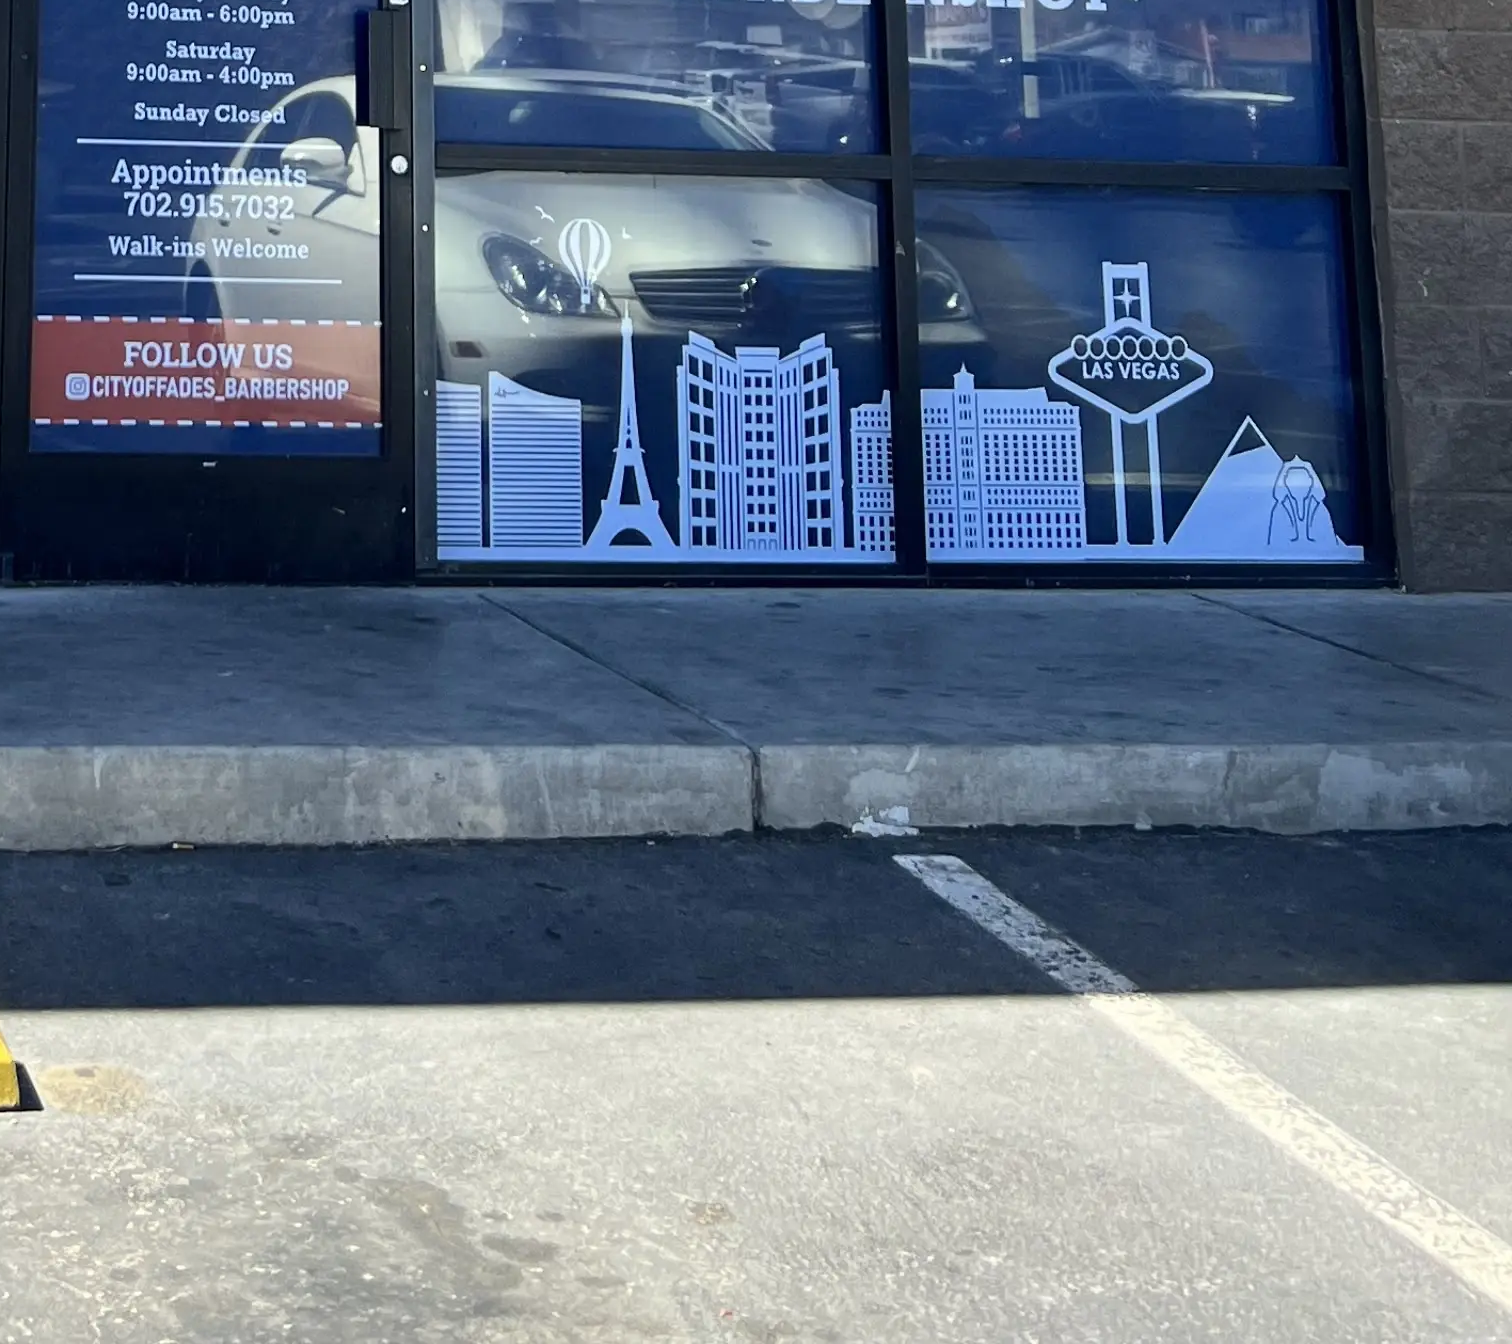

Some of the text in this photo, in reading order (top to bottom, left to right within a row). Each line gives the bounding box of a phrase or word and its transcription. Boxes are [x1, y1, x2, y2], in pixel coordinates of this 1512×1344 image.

[127, 2, 202, 21] 9:00am
[219, 4, 295, 29] 6:00pm
[165, 40, 256, 65] Saturday
[126, 63, 202, 83] 9:00am
[219, 65, 295, 90] 4:00pm
[134, 102, 286, 127] Sunday Closed
[111, 159, 308, 190] Appointments
[124, 192, 295, 221] 702.915.7032
[109, 235, 309, 259] Walk-ins Welcome
[123, 341, 294, 370] FOLLOW US
[1082, 361, 1180, 380] LAS VEGAS
[92, 375, 350, 401] CITYOFFADES_BARBERSHOP
